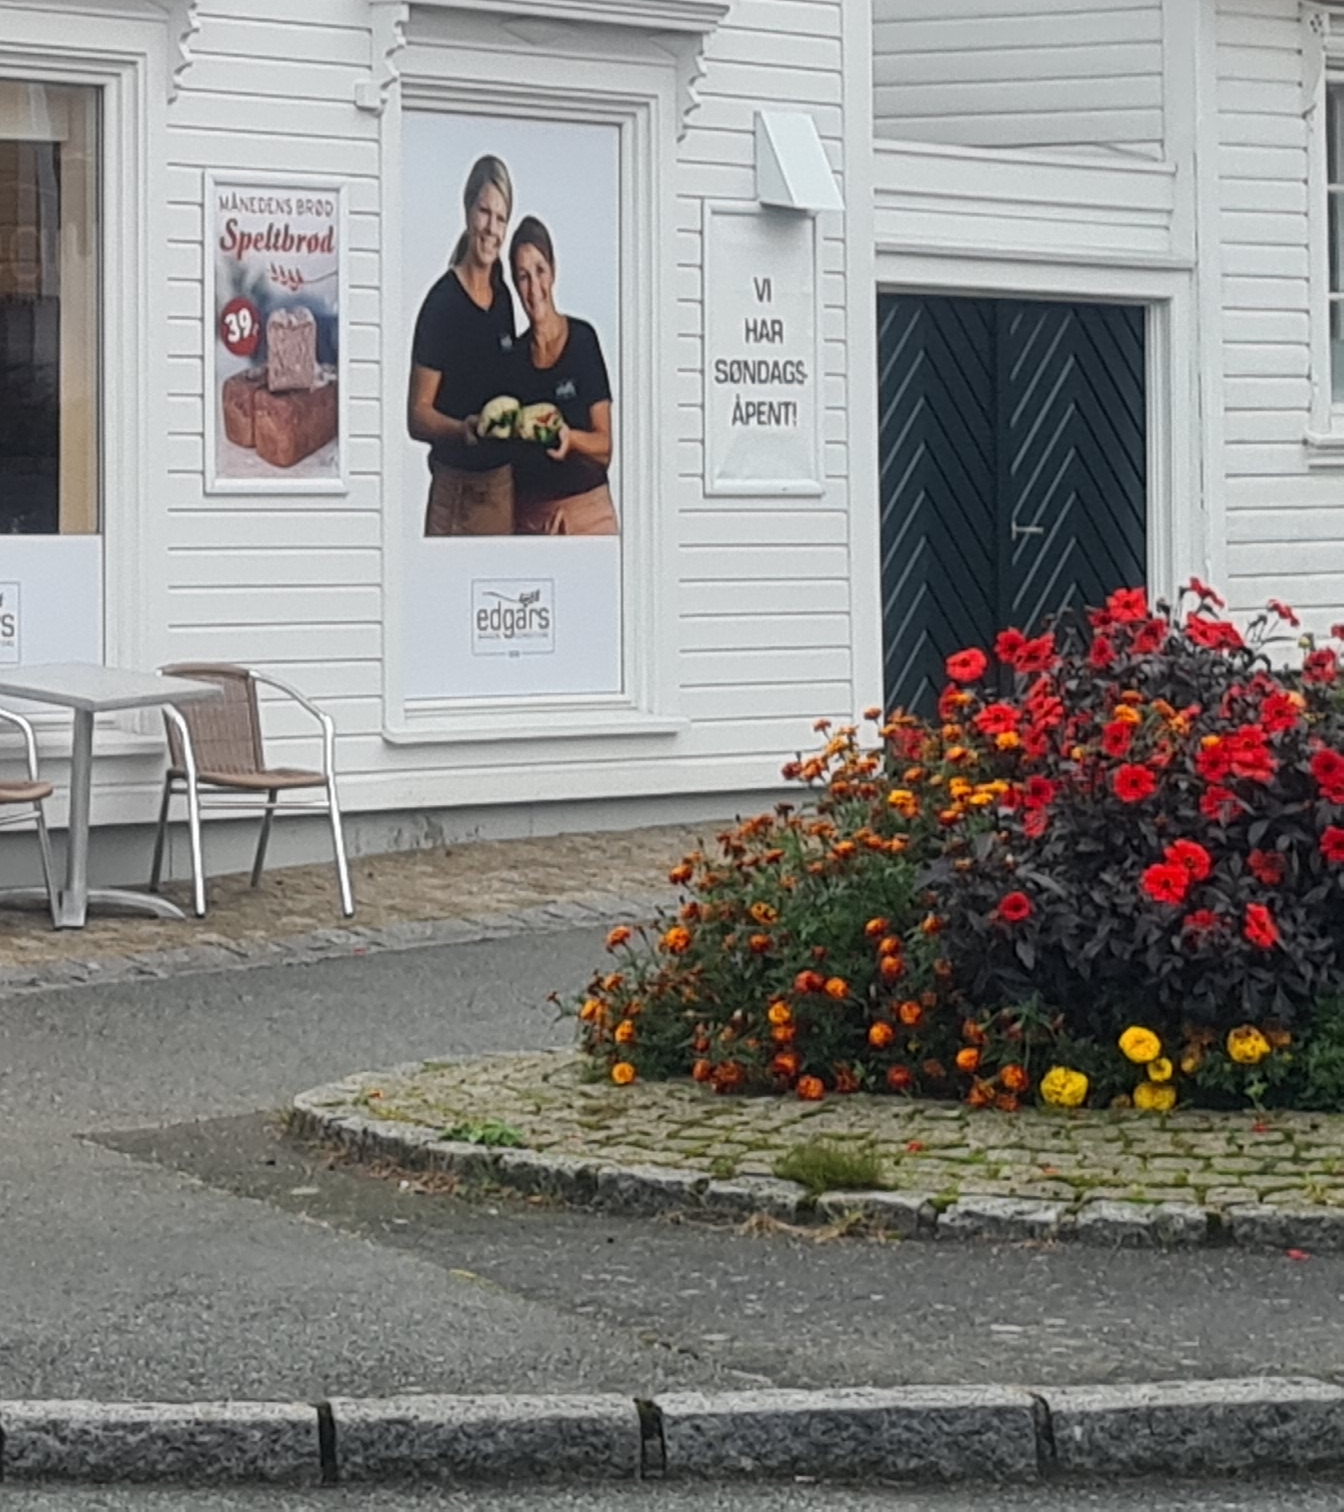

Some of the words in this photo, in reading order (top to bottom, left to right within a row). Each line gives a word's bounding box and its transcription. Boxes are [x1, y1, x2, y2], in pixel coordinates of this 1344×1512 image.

[218, 191, 293, 216] MÅNEDENS
[295, 198, 334, 218] BRØD
[219, 218, 336, 262] Speltbrød
[753, 276, 772, 304] VI
[744, 317, 784, 345] HAR
[714, 358, 809, 386] SØNDAGS-
[731, 392, 798, 428] ÅPENT!
[476, 600, 550, 639] edgars
